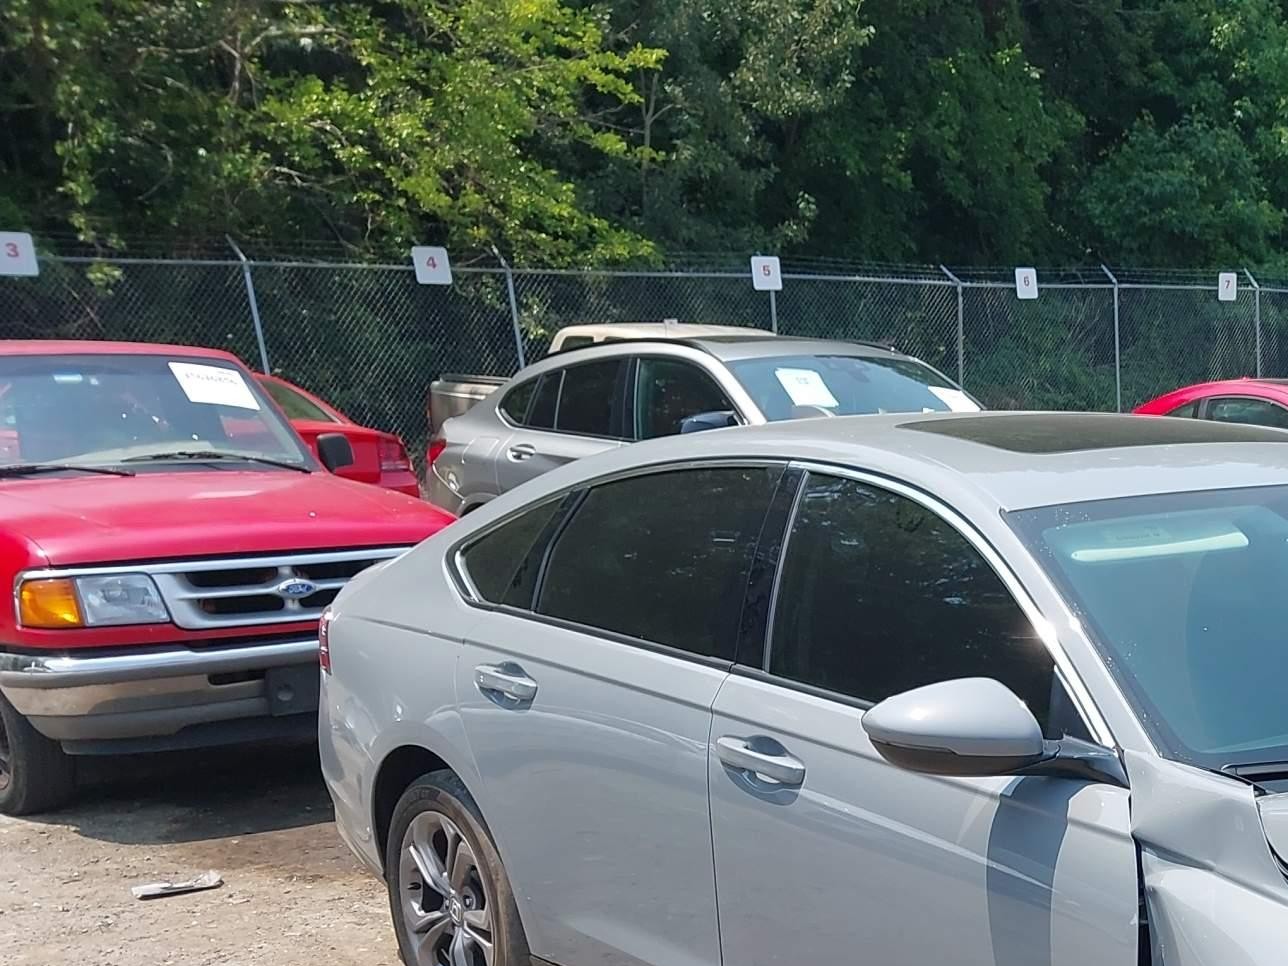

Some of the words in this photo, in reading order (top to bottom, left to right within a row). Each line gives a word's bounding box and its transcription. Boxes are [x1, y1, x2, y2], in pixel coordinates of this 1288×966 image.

[5, 242, 19, 257] 3
[426, 256, 437, 269] 4
[762, 265, 770, 276] 5
[1023, 276, 1030, 287] 6
[1225, 280, 1231, 289] 7
